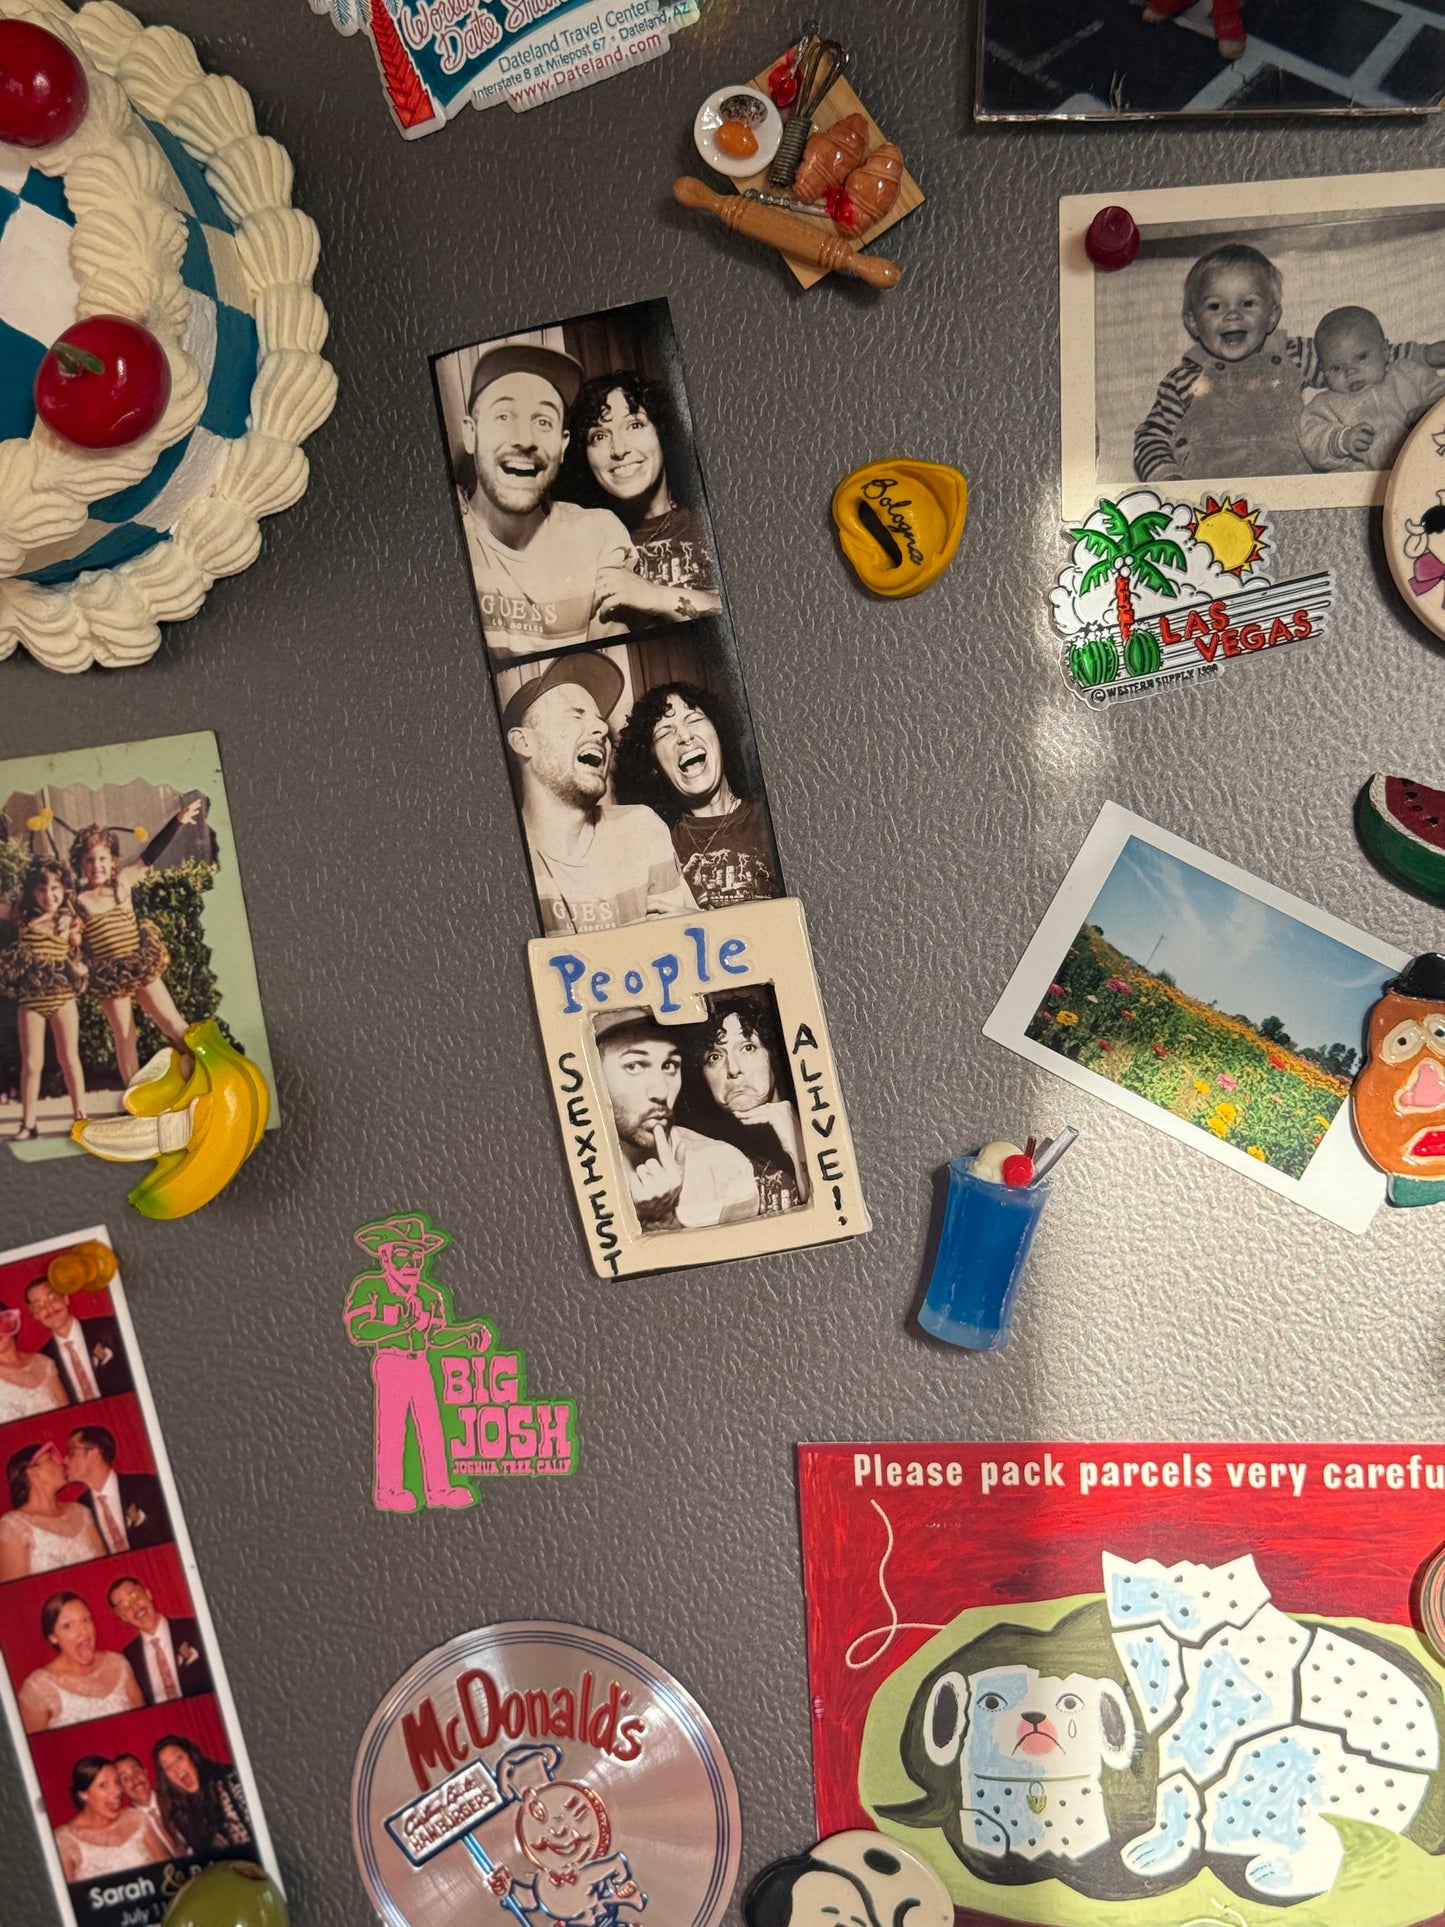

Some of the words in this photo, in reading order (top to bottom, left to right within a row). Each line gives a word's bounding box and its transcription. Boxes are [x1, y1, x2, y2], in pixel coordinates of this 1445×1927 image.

[437, 10, 500, 72] Date
[472, 73, 522, 100] Interstate
[523, 67, 532, 80] 8
[534, 63, 545, 76] at
[545, 43, 592, 71] Milepost
[592, 37, 606, 52] 67
[618, 10, 671, 40] Dateland,
[672, 1, 692, 18] AZ
[498, 34, 560, 73] Dateland
[560, 16, 604, 47] Travel
[605, 1, 651, 28] Center
[510, 34, 662, 103] www.Dateland.com
[480, 594, 558, 626] GUESS
[1158, 600, 1230, 645] LAS
[1194, 608, 1313, 663] VEGAS
[1106, 678, 1155, 698] WESTERN
[1156, 668, 1195, 686] SUPPLY
[549, 927, 749, 1014] People
[792, 1022, 849, 1227] ALIVE!
[558, 1052, 623, 1276] SEXIEST
[441, 1354, 519, 1404] BIG
[450, 1404, 572, 1459] JOSH
[452, 1459, 499, 1475] JOSHUA
[853, 1453, 964, 1488] Please
[980, 1453, 1065, 1494] pack
[1079, 1453, 1213, 1495] parcels
[1226, 1463, 1307, 1497] very
[1323, 1454, 1445, 1490] carefu
[401, 1668, 647, 1792] McDonald's
[409, 1789, 495, 1851] HAMBURGERS
[89, 1876, 156, 1909] Sarah
[161, 1863, 186, 1896] &
[121, 1906, 150, 1927] July
